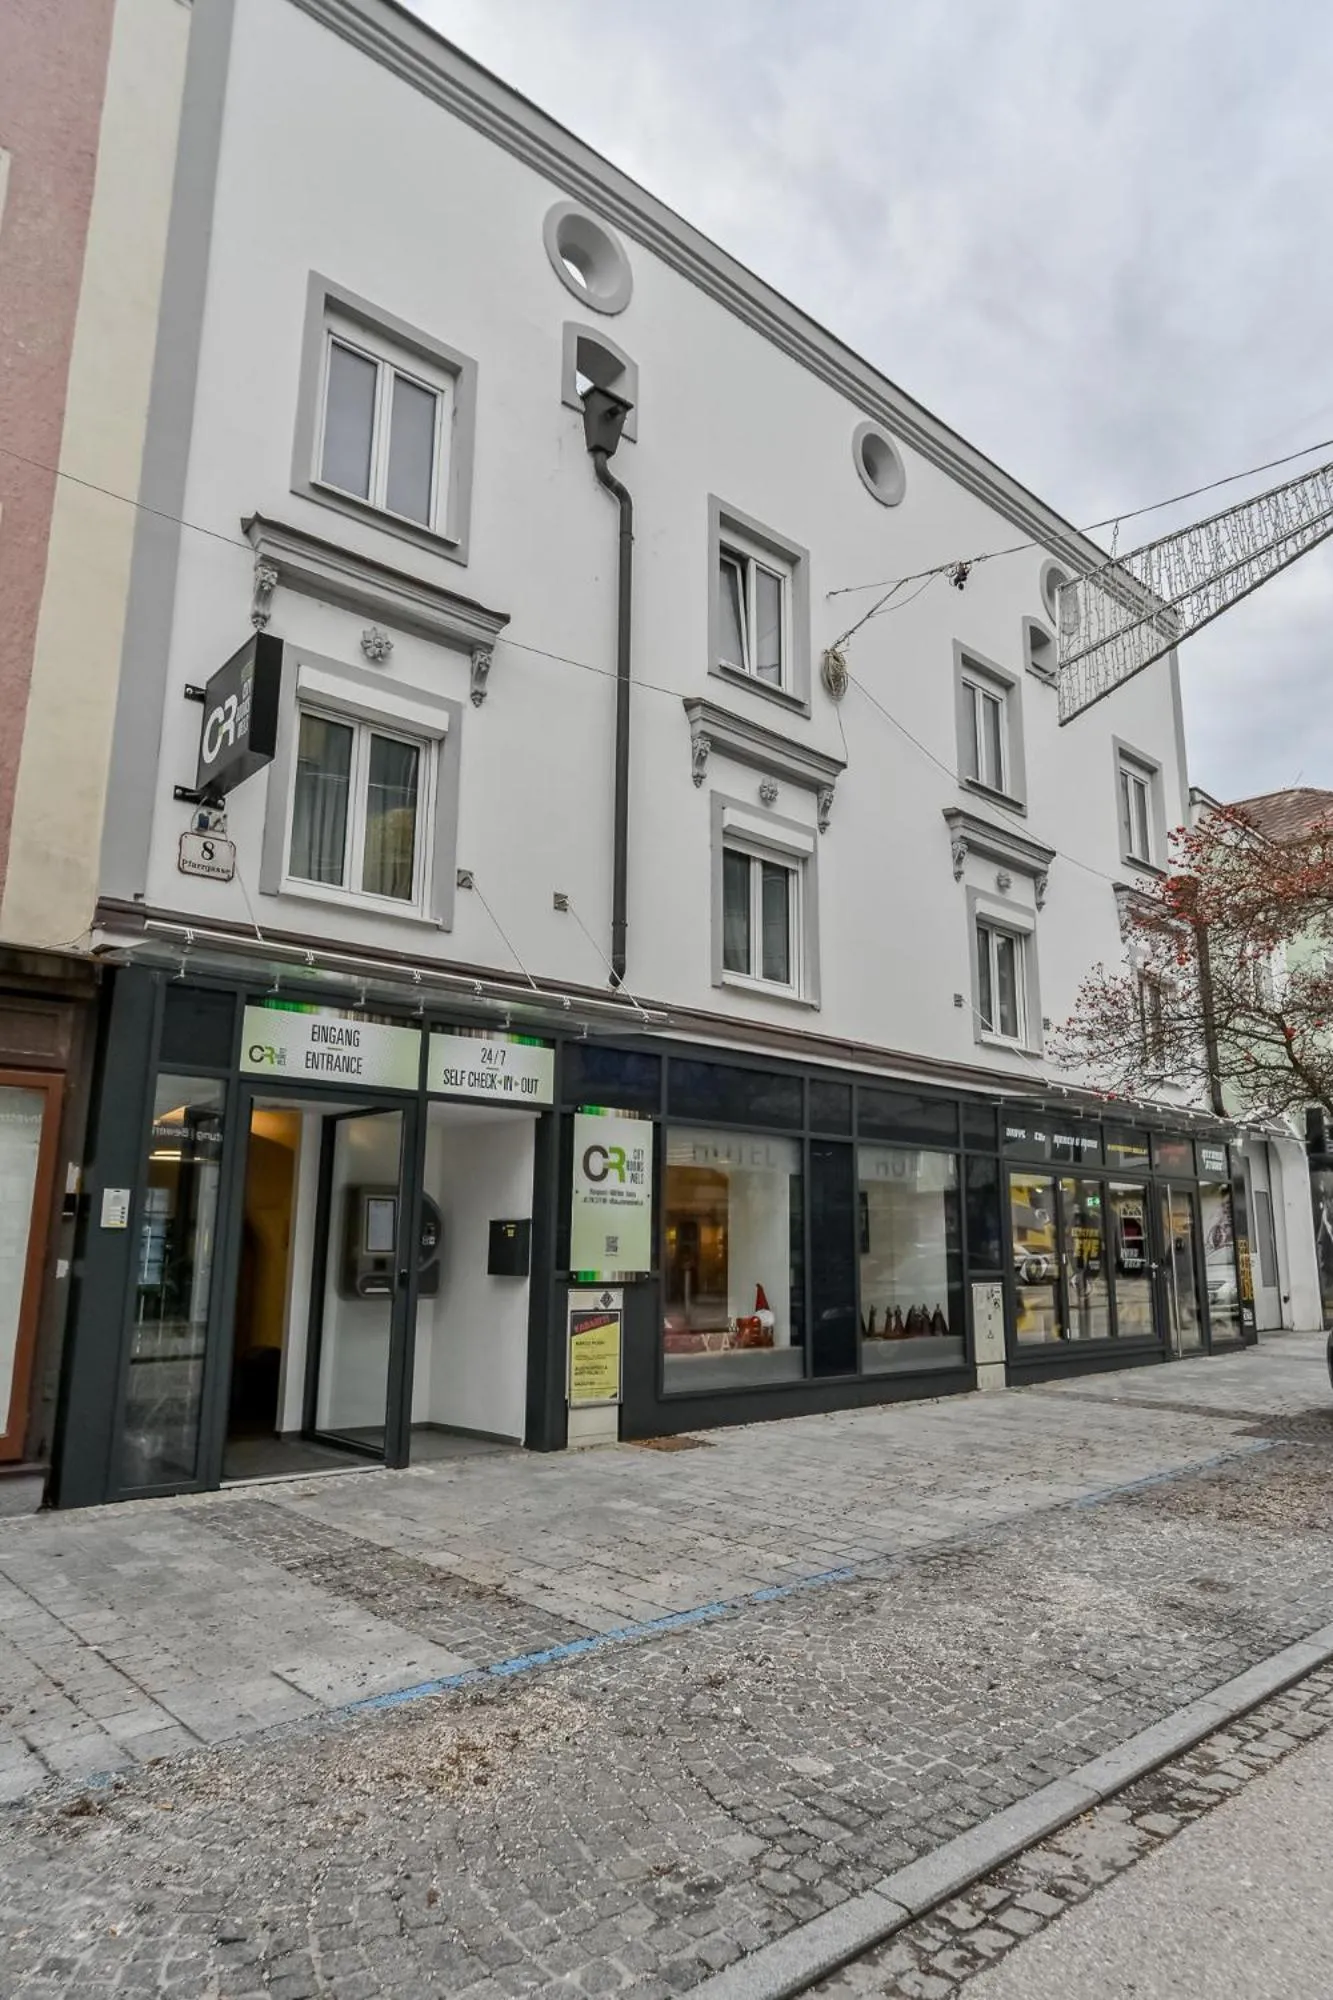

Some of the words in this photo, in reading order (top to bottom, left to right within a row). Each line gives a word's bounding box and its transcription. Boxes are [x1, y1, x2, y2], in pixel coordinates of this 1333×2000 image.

[202, 695, 237, 764] CR
[201, 841, 214, 860] 8
[182, 859, 231, 873] Pfarrgasse
[311, 1024, 360, 1048] EINGANG
[248, 1045, 275, 1065] CR
[305, 1051, 363, 1075] ENTRANCE
[480, 1047, 506, 1066] 24/7
[443, 1068, 466, 1087] SELF
[467, 1071, 498, 1090] CHECK
[503, 1075, 513, 1092] IN
[520, 1077, 539, 1095] OUT
[582, 1145, 626, 1183] CR
